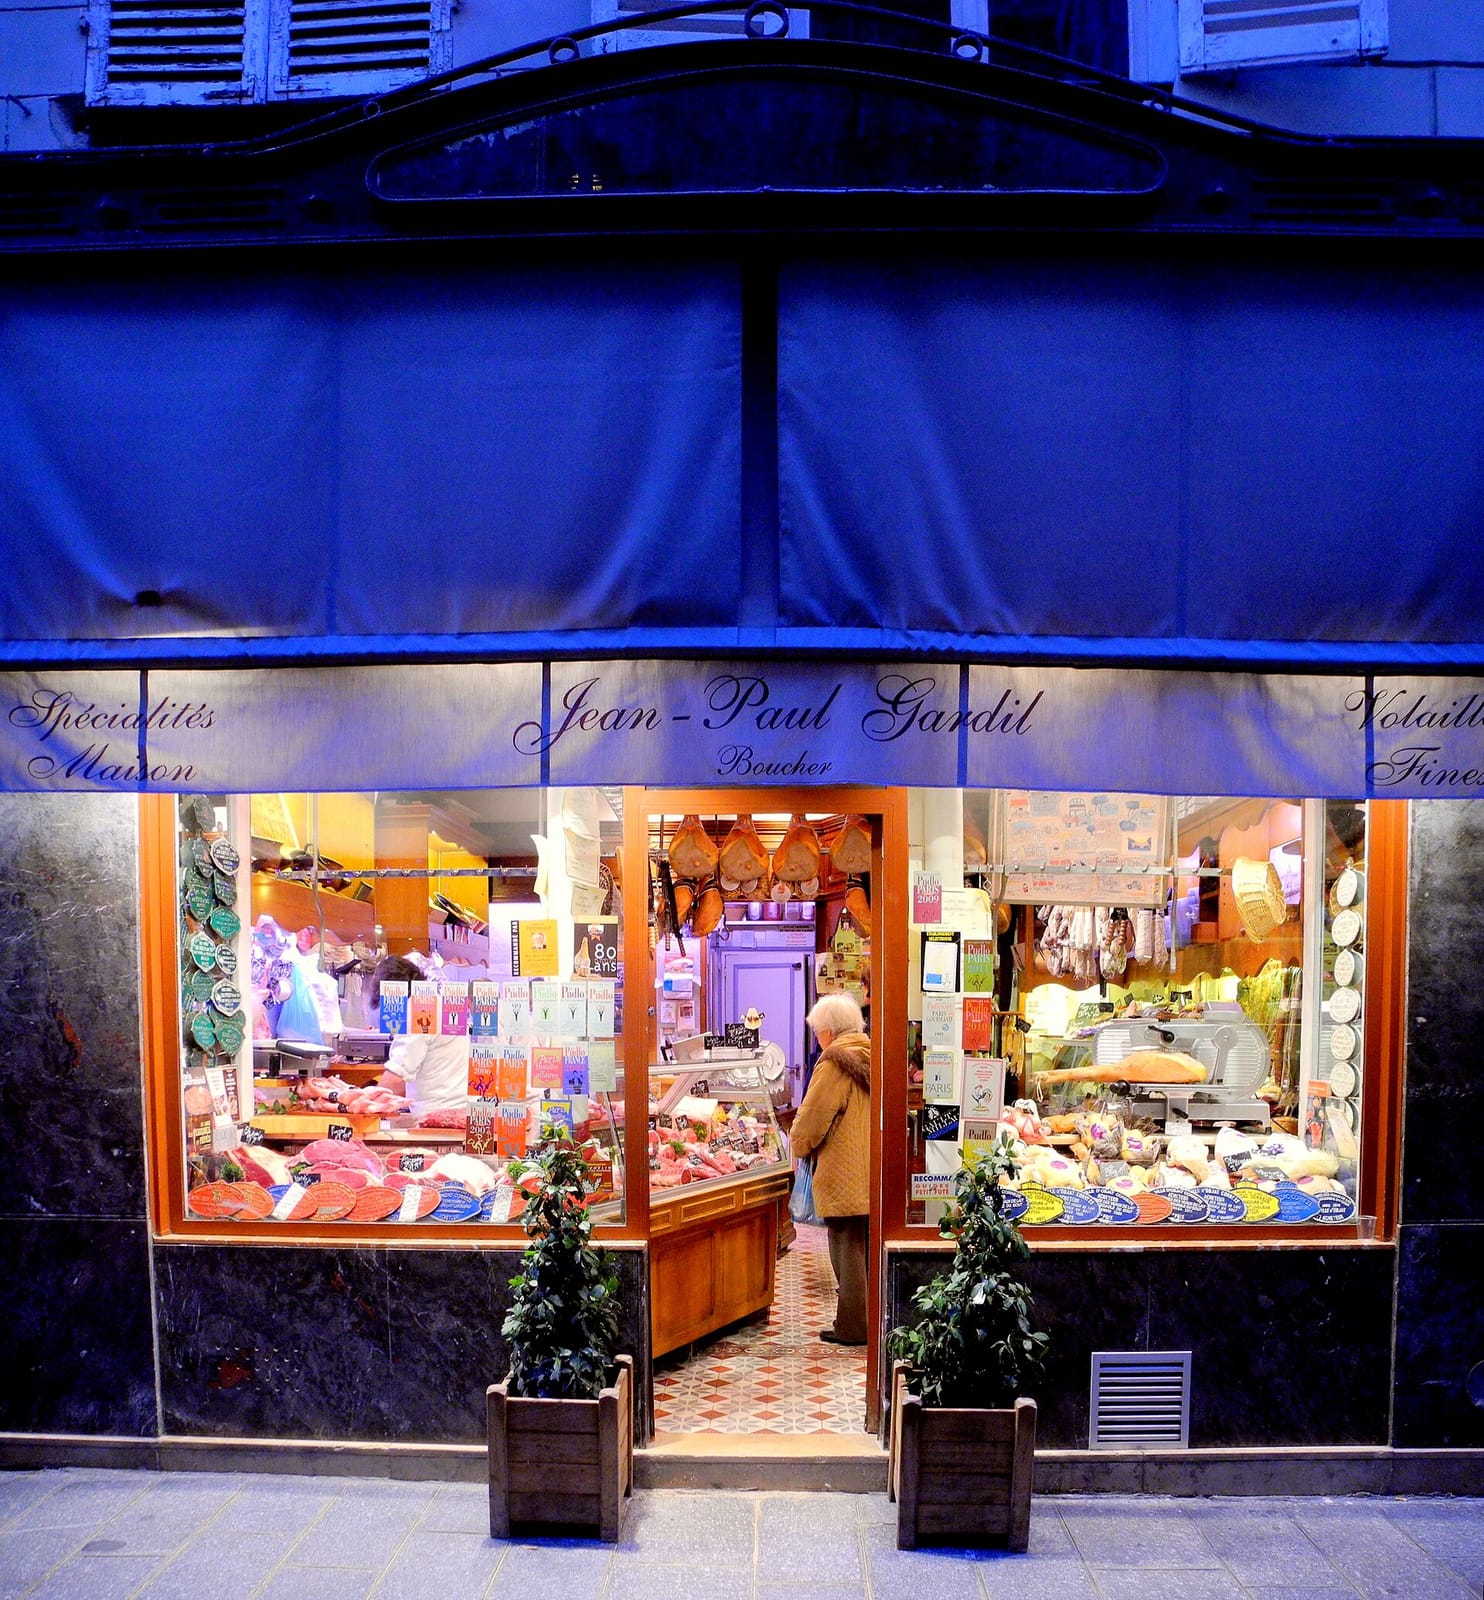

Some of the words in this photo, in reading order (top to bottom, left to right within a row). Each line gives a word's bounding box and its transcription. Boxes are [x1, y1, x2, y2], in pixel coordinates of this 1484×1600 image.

[9, 689, 216, 741] Spécialités
[513, 677, 661, 755] Jean
[703, 675, 843, 730] Paul
[861, 674, 1045, 742] Gardil
[1344, 689, 1484, 731] Volaill
[27, 743, 198, 781] Maison
[717, 745, 832, 776] Boucher
[917, 885, 939, 894] PARIS
[917, 895, 939, 904] 2009
[594, 943, 617, 959] 80
[968, 943, 990, 954] Pudlo
[967, 954, 990, 963] PARIS
[594, 961, 617, 972] ans
[925, 1083, 952, 1094] PARIS
[470, 1125, 490, 1134] 2007
